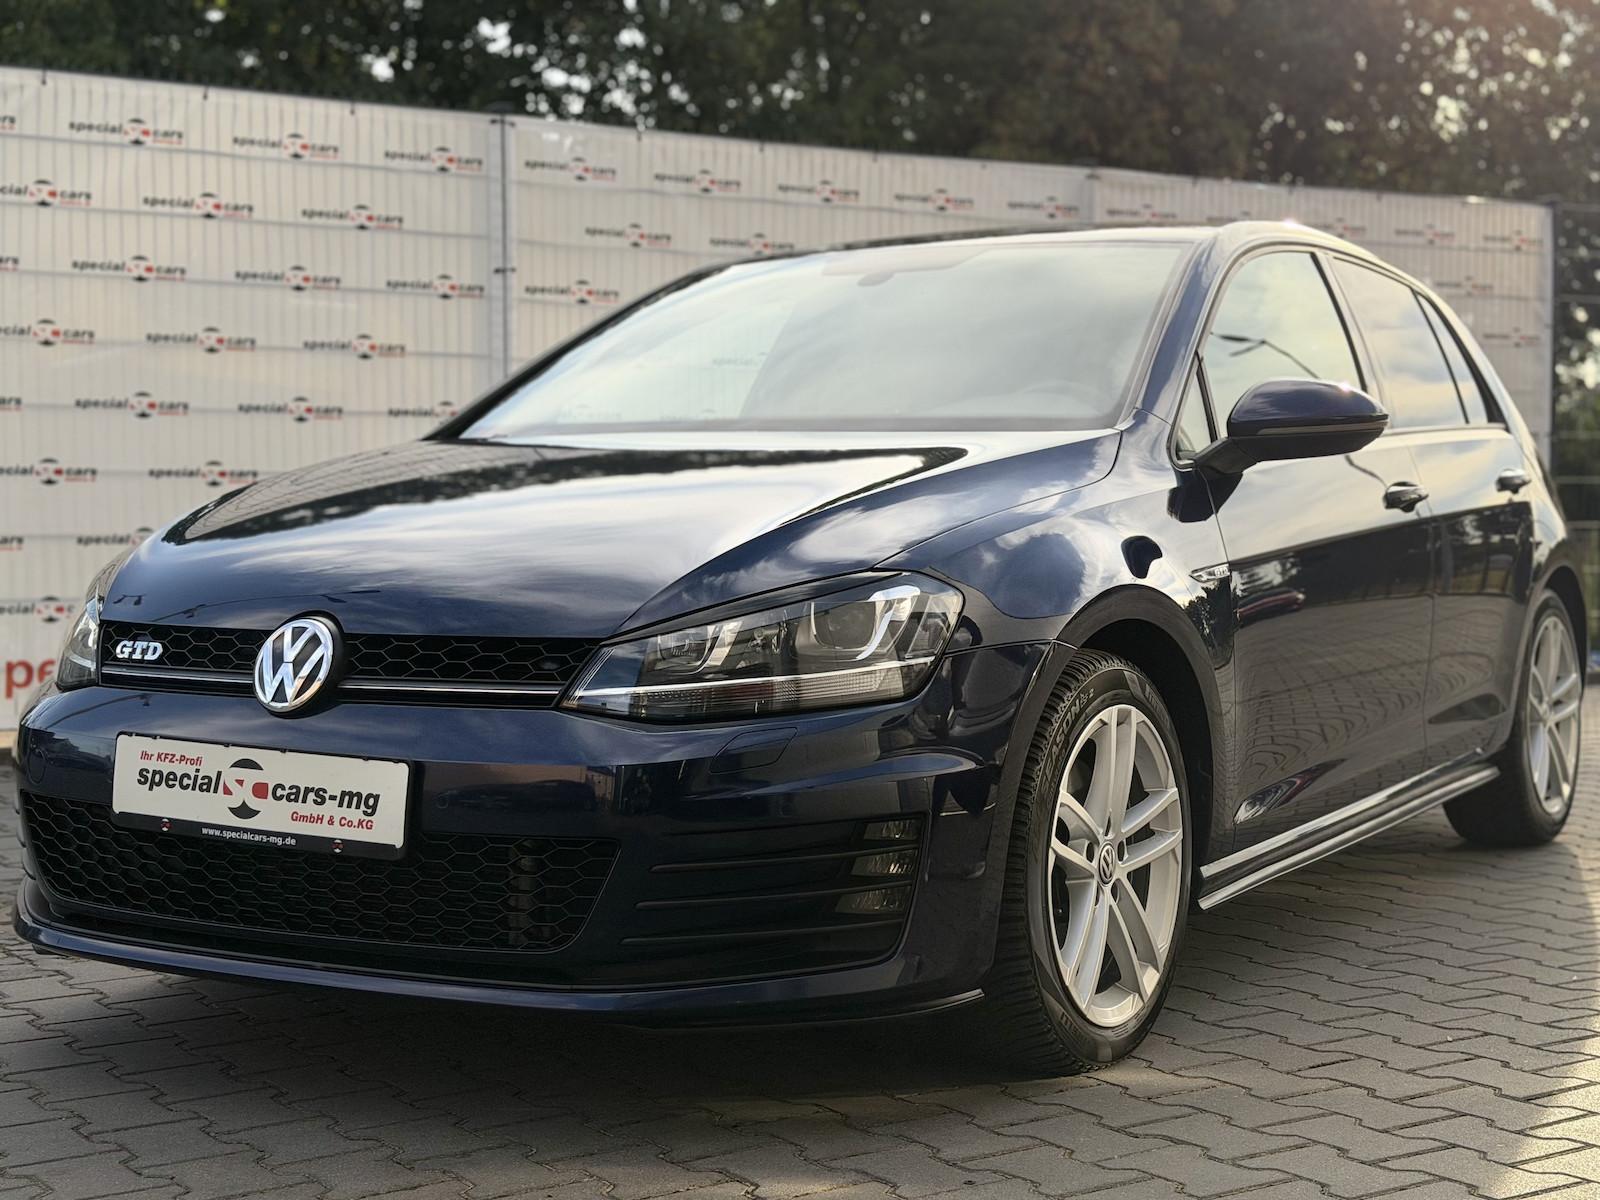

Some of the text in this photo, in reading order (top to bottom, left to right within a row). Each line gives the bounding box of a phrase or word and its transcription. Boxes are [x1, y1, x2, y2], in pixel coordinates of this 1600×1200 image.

[69, 120, 123, 133] special
[233, 135, 283, 147] special
[143, 196, 195, 208] special
[301, 207, 349, 219] special
[72, 260, 126, 271] special
[235, 270, 285, 281] special
[146, 332, 198, 343] special
[304, 340, 352, 351] special
[75, 398, 128, 409] special
[238, 403, 288, 414] special
[149, 468, 201, 479] special
[77, 535, 129, 545] special
[116, 640, 163, 661] GTD
[140, 750, 203, 767] Ihr KFZ-Profi
[137, 767, 380, 817] special cars-mg
[291, 811, 374, 831] GmbH & Co.KG
[202, 827, 296, 845] www.specialcars-mg.de
